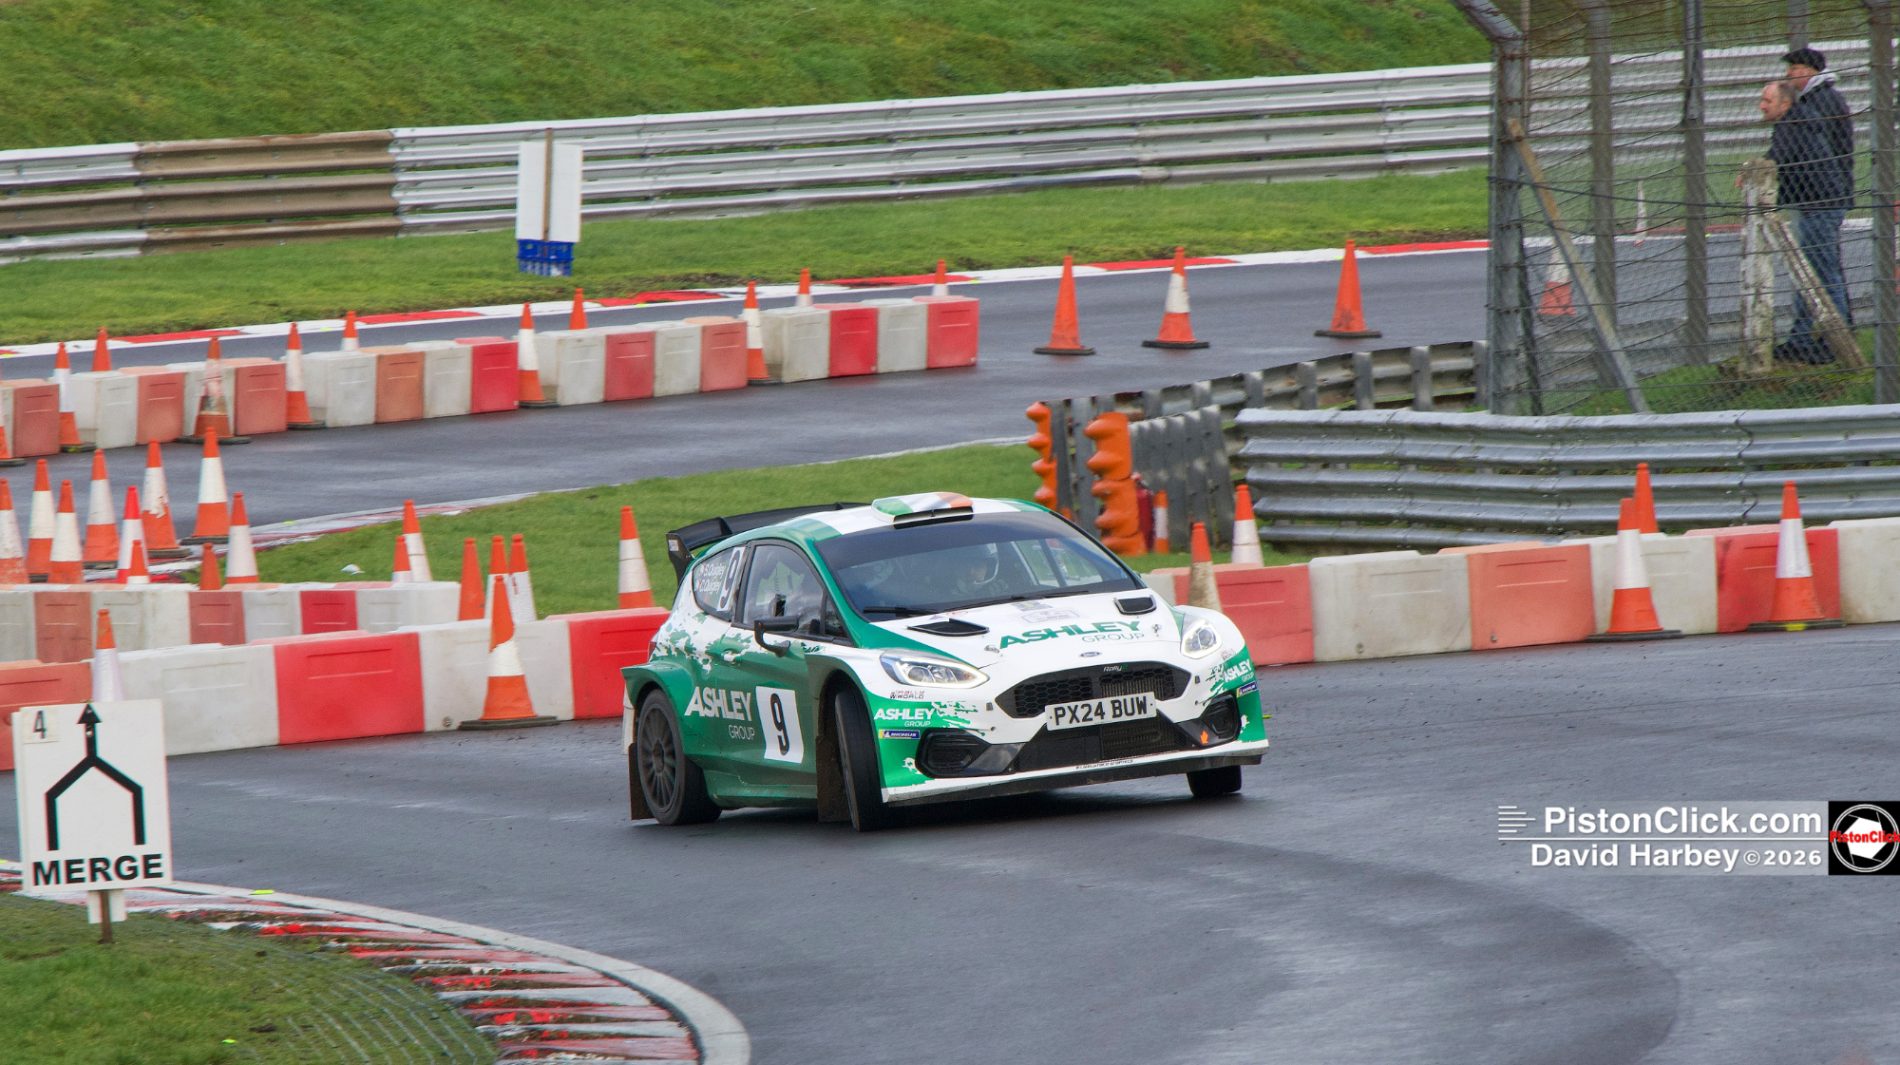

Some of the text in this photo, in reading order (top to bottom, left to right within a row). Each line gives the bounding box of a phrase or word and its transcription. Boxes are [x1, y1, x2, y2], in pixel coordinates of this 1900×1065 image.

[1000, 621, 1140, 649] ASHLEY
[1082, 633, 1144, 642] GROUP
[684, 686, 752, 721] ASHLEY
[874, 708, 935, 720] ASHLEY
[1053, 695, 1148, 726] PX24 BUW
[33, 710, 47, 739] 4
[728, 724, 755, 740] GROUP
[770, 693, 790, 756] 9
[32, 853, 164, 887] MERGE
